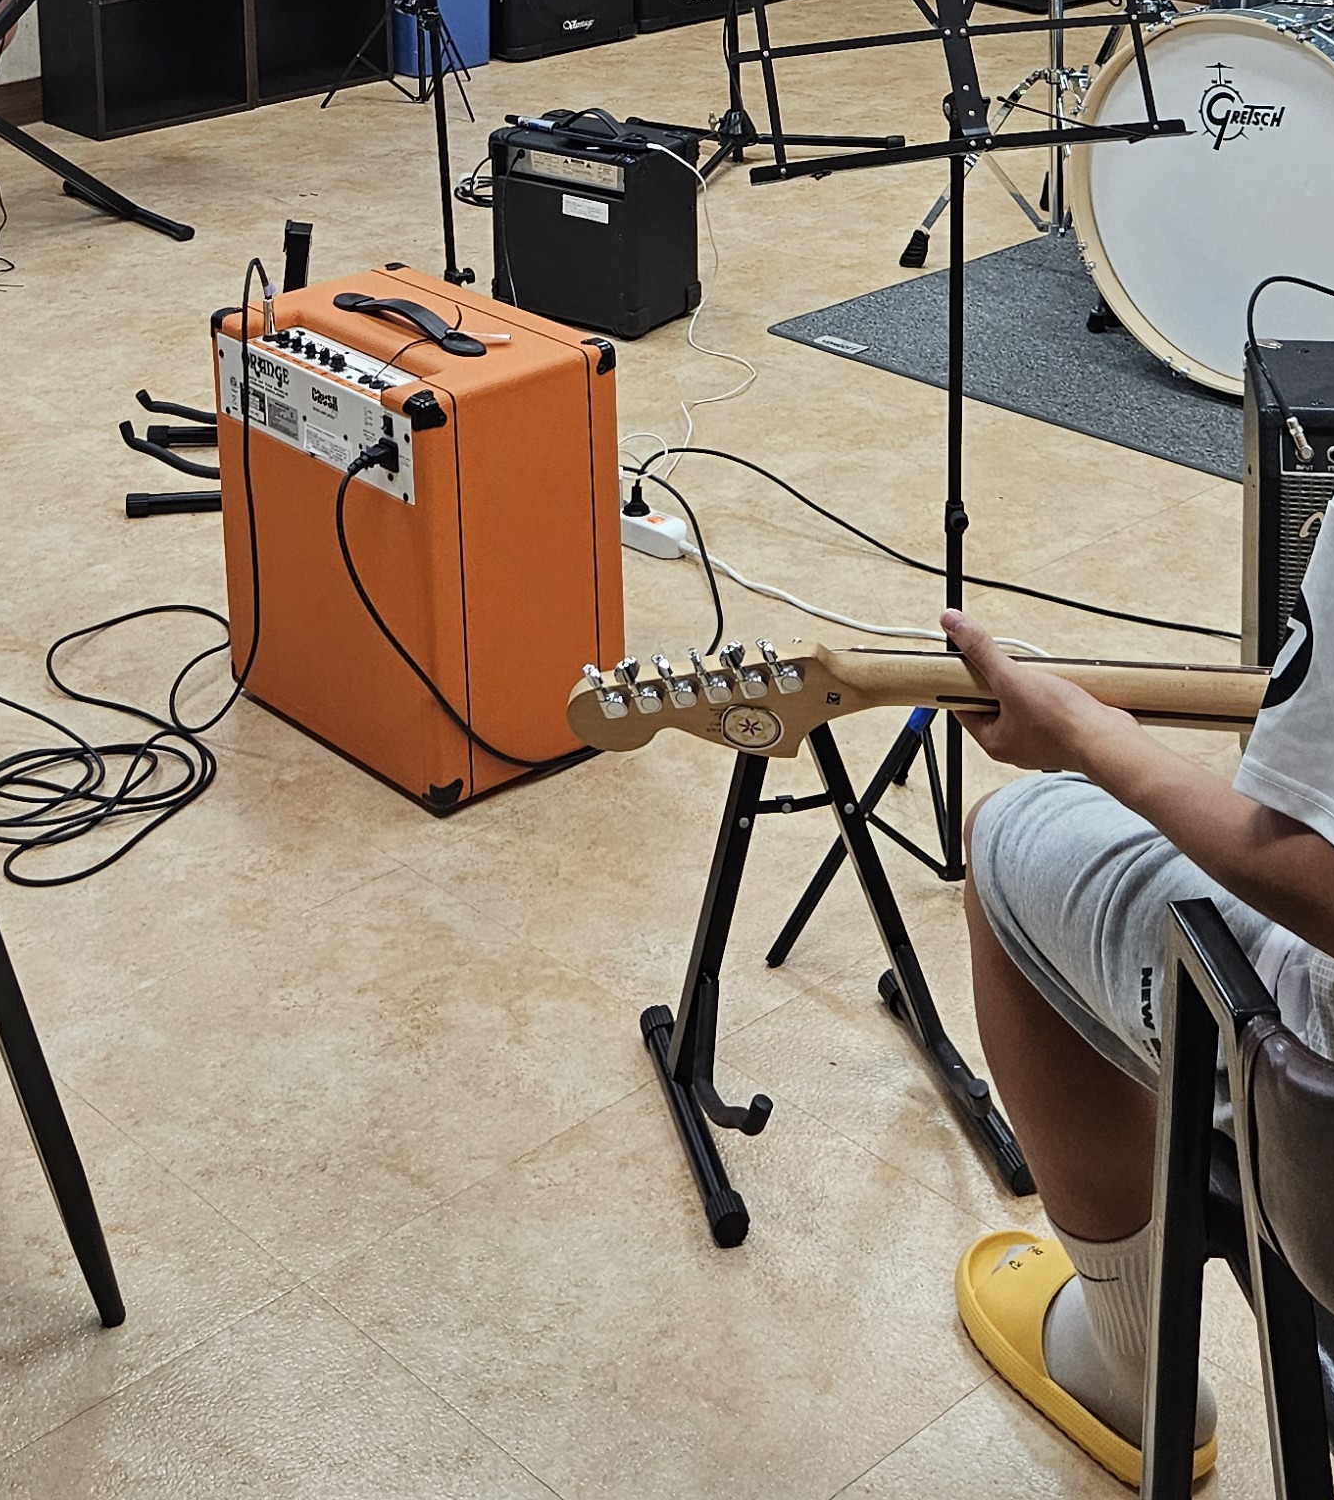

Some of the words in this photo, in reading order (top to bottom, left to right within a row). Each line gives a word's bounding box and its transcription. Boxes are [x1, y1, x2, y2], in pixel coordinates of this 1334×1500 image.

[1206, 92, 1286, 151] GRETSCH
[246, 351, 291, 388] RANGE
[1141, 966, 1156, 1031] NEW
